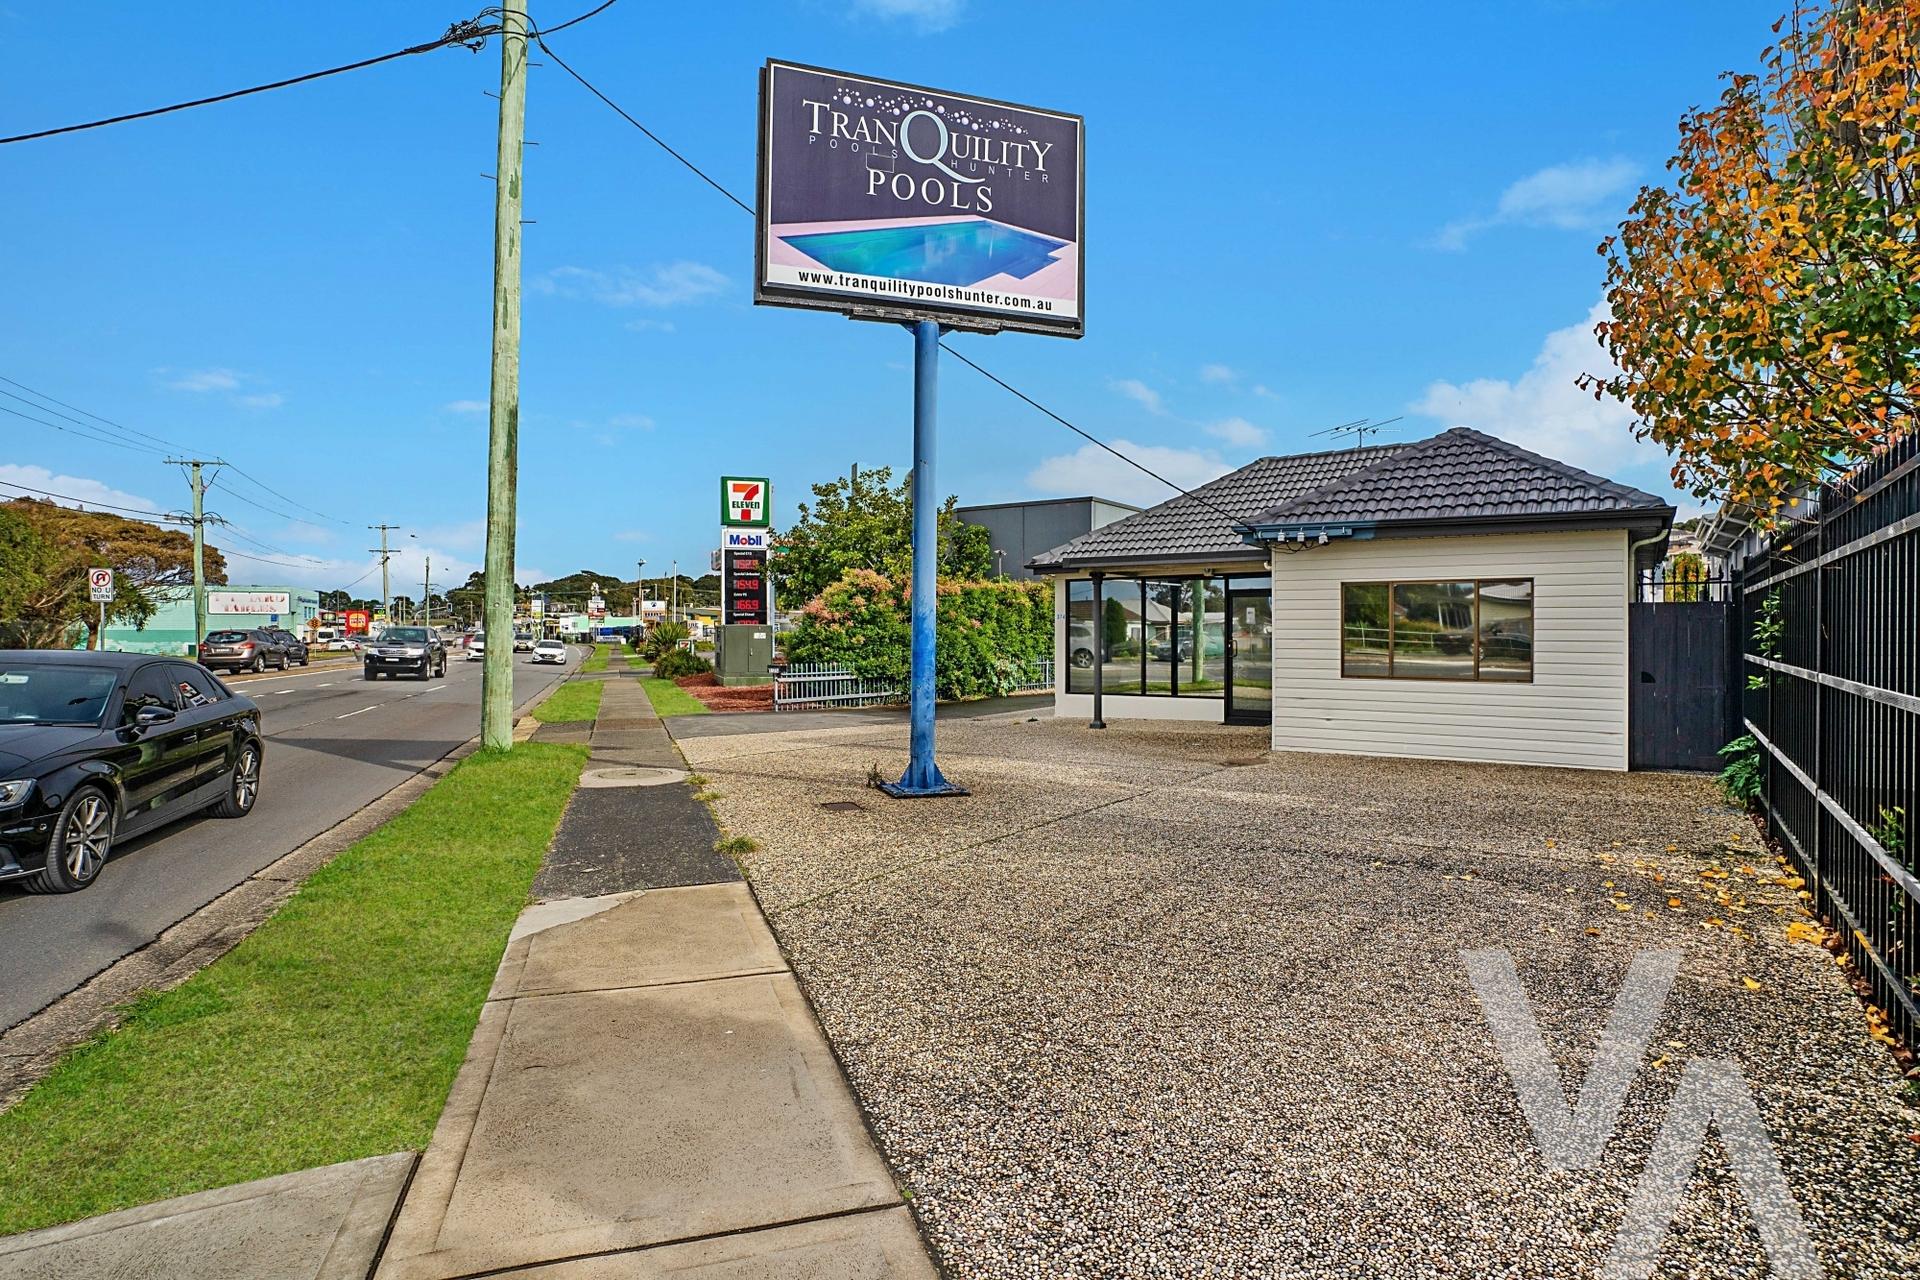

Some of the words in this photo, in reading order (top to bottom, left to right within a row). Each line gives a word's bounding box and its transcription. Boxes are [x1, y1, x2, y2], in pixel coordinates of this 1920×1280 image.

[809, 136, 898, 159] POOLS
[951, 160, 1049, 183] HUNTER
[867, 169, 993, 213] POOLS
[798, 271, 1053, 311] www.tranquilitypoolshunter.com.au
[733, 484, 759, 521] 7
[729, 534, 762, 546] Mobil
